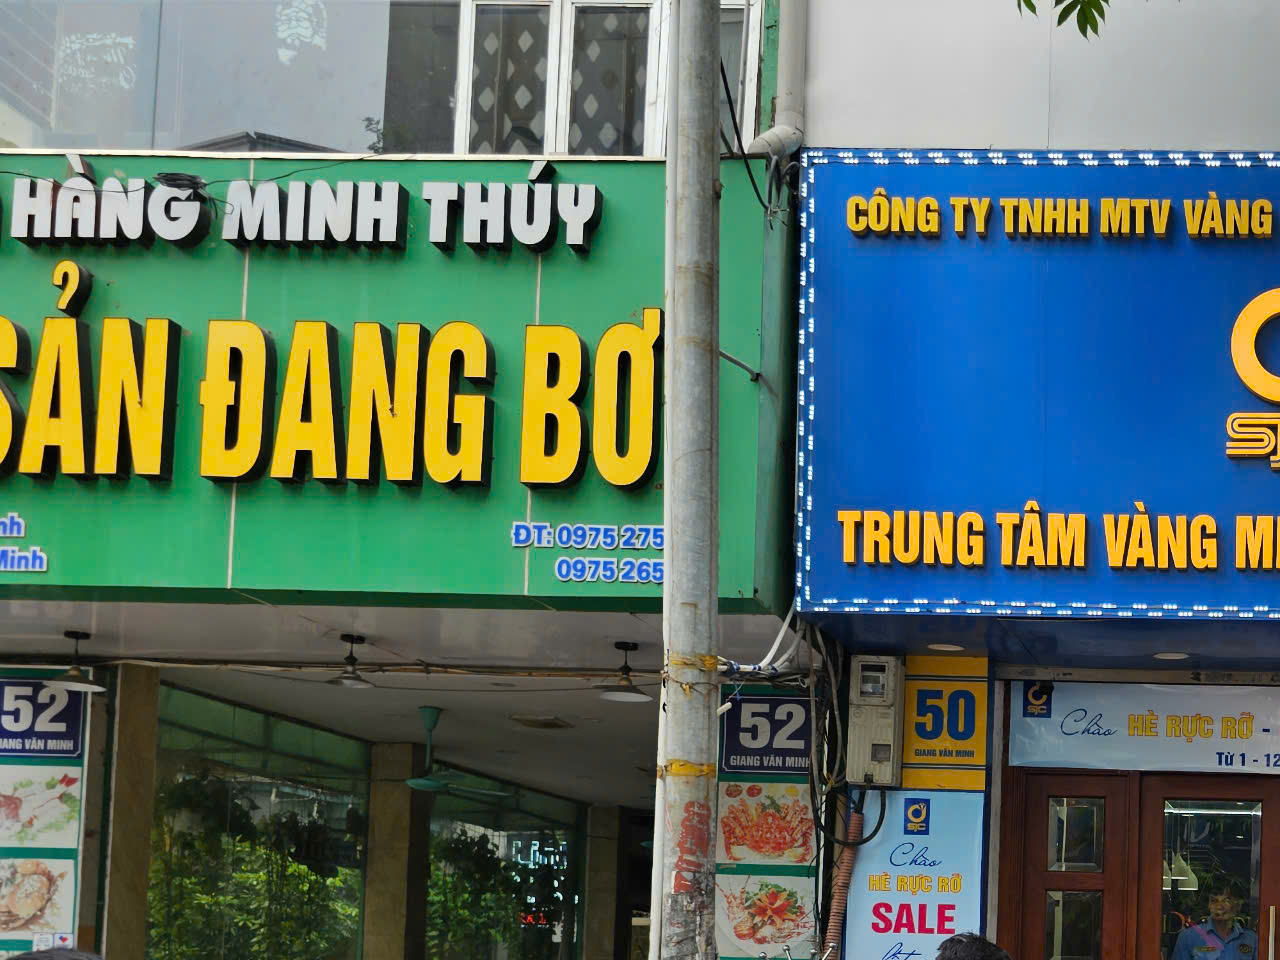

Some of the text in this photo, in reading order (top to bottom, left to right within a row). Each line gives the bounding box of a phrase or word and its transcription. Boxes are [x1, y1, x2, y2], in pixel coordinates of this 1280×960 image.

[11, 155, 597, 246] HÀNG MINH THÚY
[846, 187, 939, 233] CÔNG
[950, 197, 991, 233] TY
[1000, 198, 1089, 235] TNHH
[1100, 199, 1171, 235] MTV
[1184, 191, 1273, 236] VÀNG
[200, 319, 490, 483] ĐANG
[520, 307, 664, 485] BƠ
[512, 522, 553, 547] ĐT:
[556, 523, 618, 549] 0975
[620, 525, 664, 550] 275
[837, 509, 984, 566] TRUNG
[996, 500, 1086, 567] TÂM
[1103, 501, 1218, 569] VÀNG
[555, 557, 617, 582] 0975
[619, 558, 664, 583] 265
[1, 685, 69, 733] 52
[914, 689, 976, 741] 50
[1060, 708, 1118, 737] Chào
[1128, 709, 1159, 737] HÈ
[1166, 712, 1213, 743] RỰC
[1221, 711, 1255, 740] RỠ
[739, 703, 806, 749] 52
[0, 736, 74, 751] IANG VĂN MINH
[915, 747, 975, 758] GIANG VĂN MINH
[1216, 751, 1234, 767] Từ
[1239, 752, 1246, 767] 1
[729, 755, 760, 768] GIANG
[762, 753, 783, 768] VĂN
[889, 842, 943, 867] Chào
[868, 871, 963, 896] HÈ RỰC RỠ
[871, 902, 956, 935] SALE
